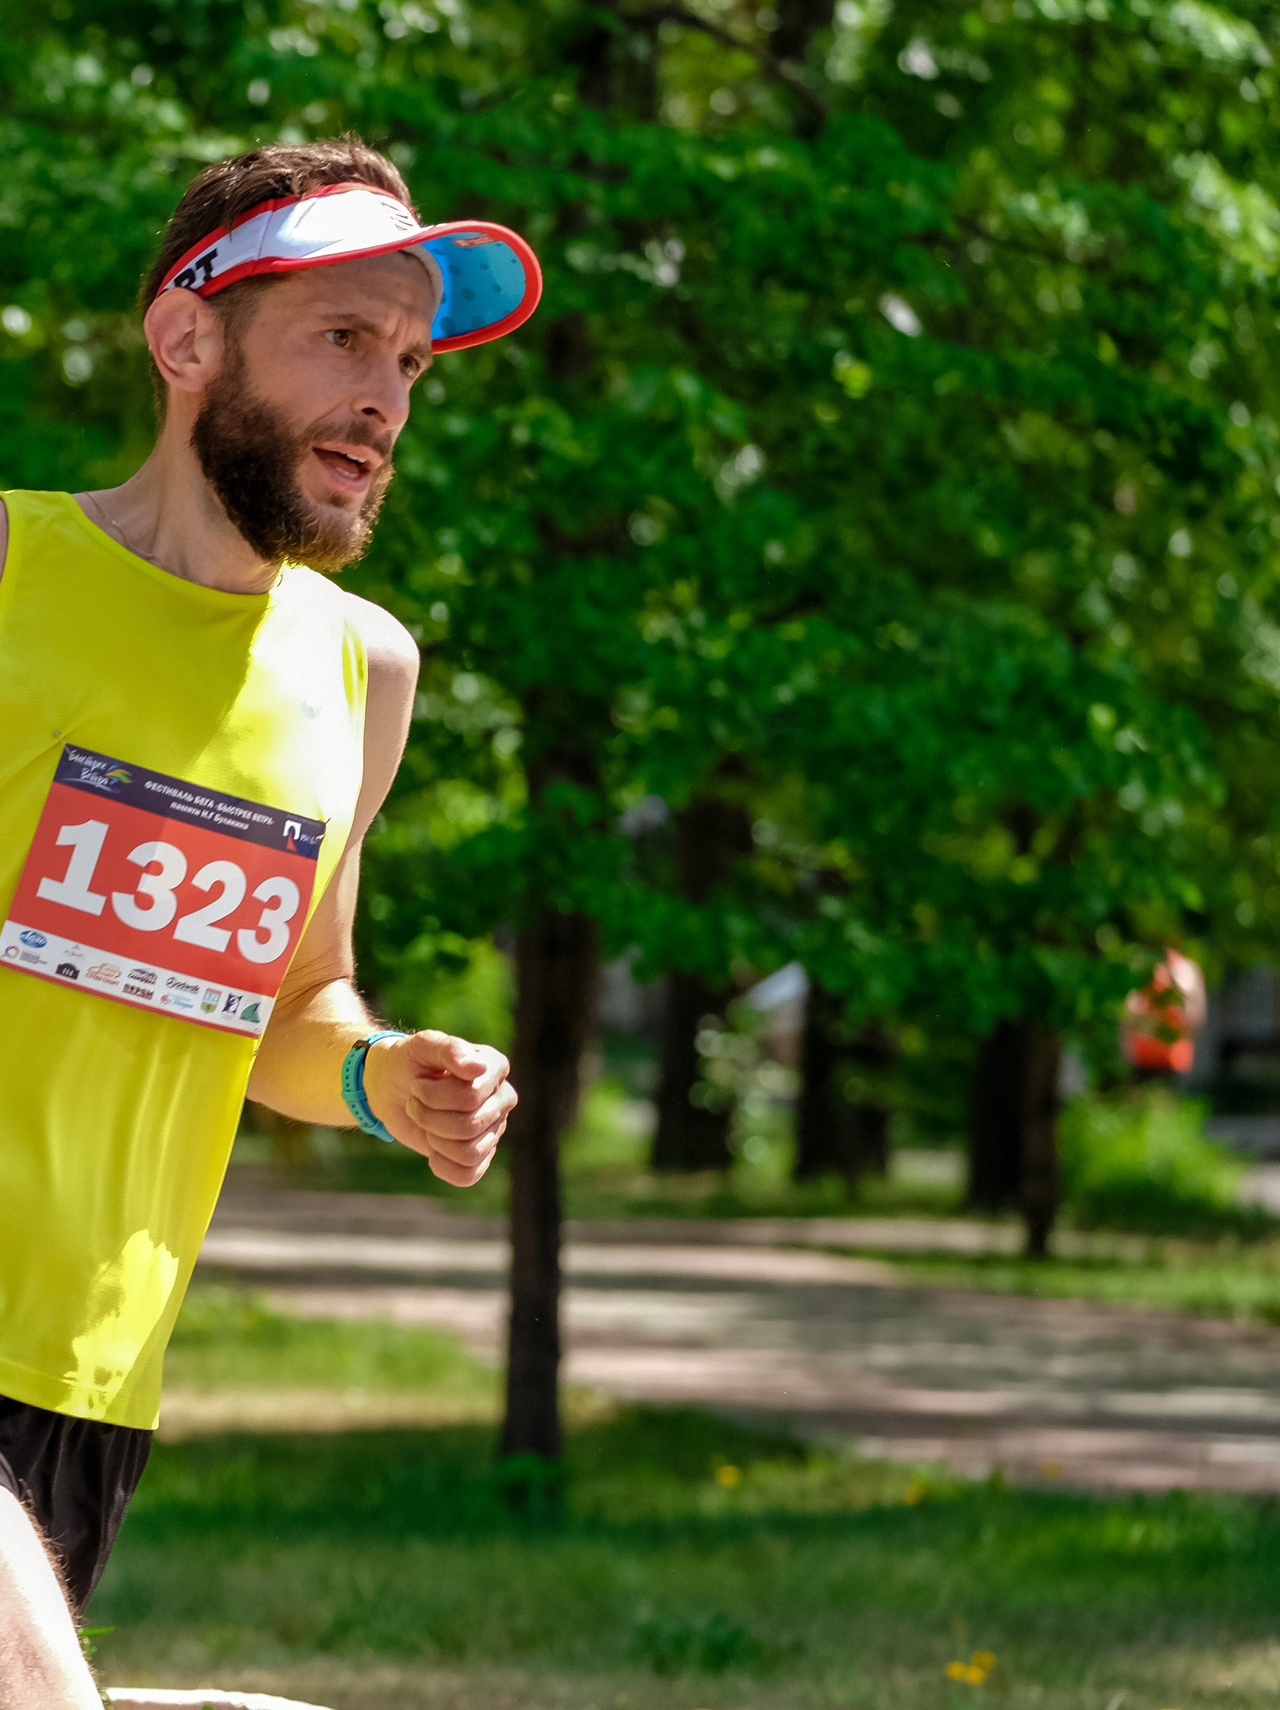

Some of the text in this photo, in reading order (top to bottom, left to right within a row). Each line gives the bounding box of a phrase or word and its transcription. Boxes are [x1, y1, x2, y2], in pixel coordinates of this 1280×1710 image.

[144, 781, 194, 802] ФЕСТИВАЛЬ
[194, 795, 215, 809] БЕГА
[170, 801, 200, 818] памяти
[36, 819, 300, 963] 1323
